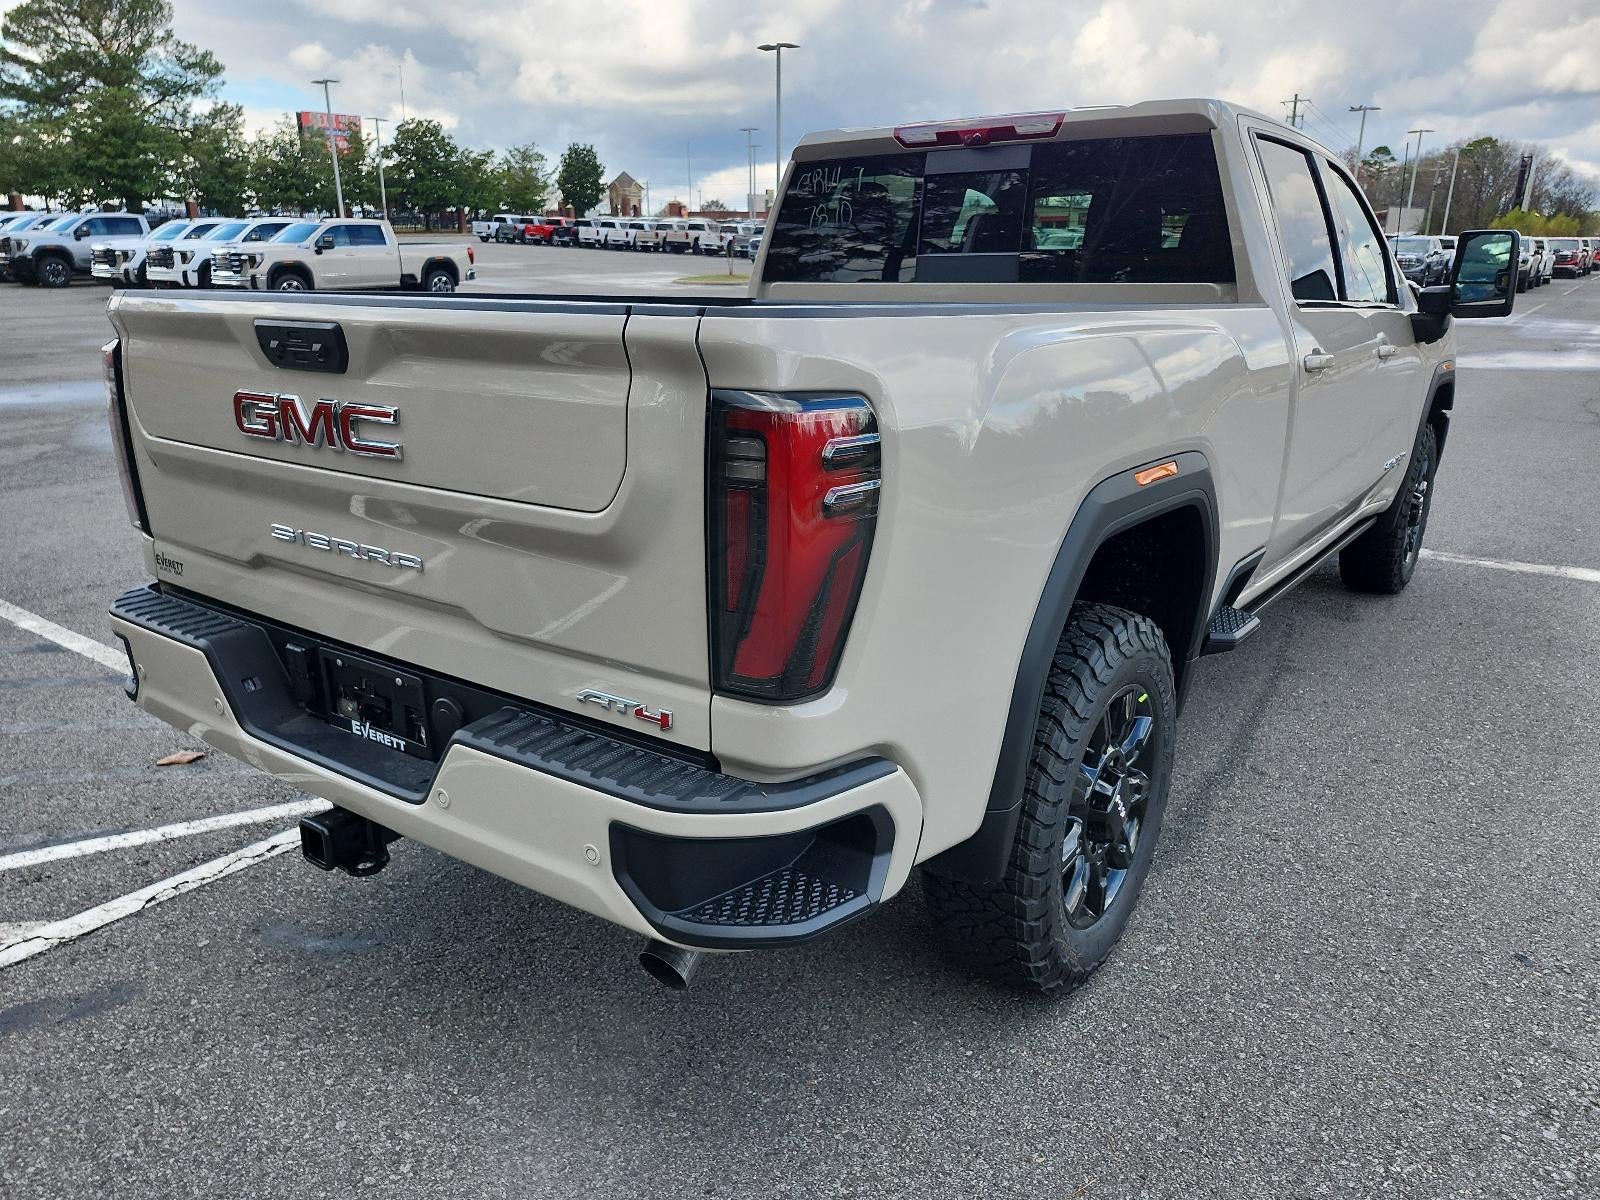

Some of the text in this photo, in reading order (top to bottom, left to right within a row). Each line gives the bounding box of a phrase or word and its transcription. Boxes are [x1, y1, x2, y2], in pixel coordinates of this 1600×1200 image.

[233, 388, 404, 461] GMC
[271, 523, 424, 573] SIERRA
[576, 688, 673, 731] AT4
[351, 720, 406, 751] EVERETT
